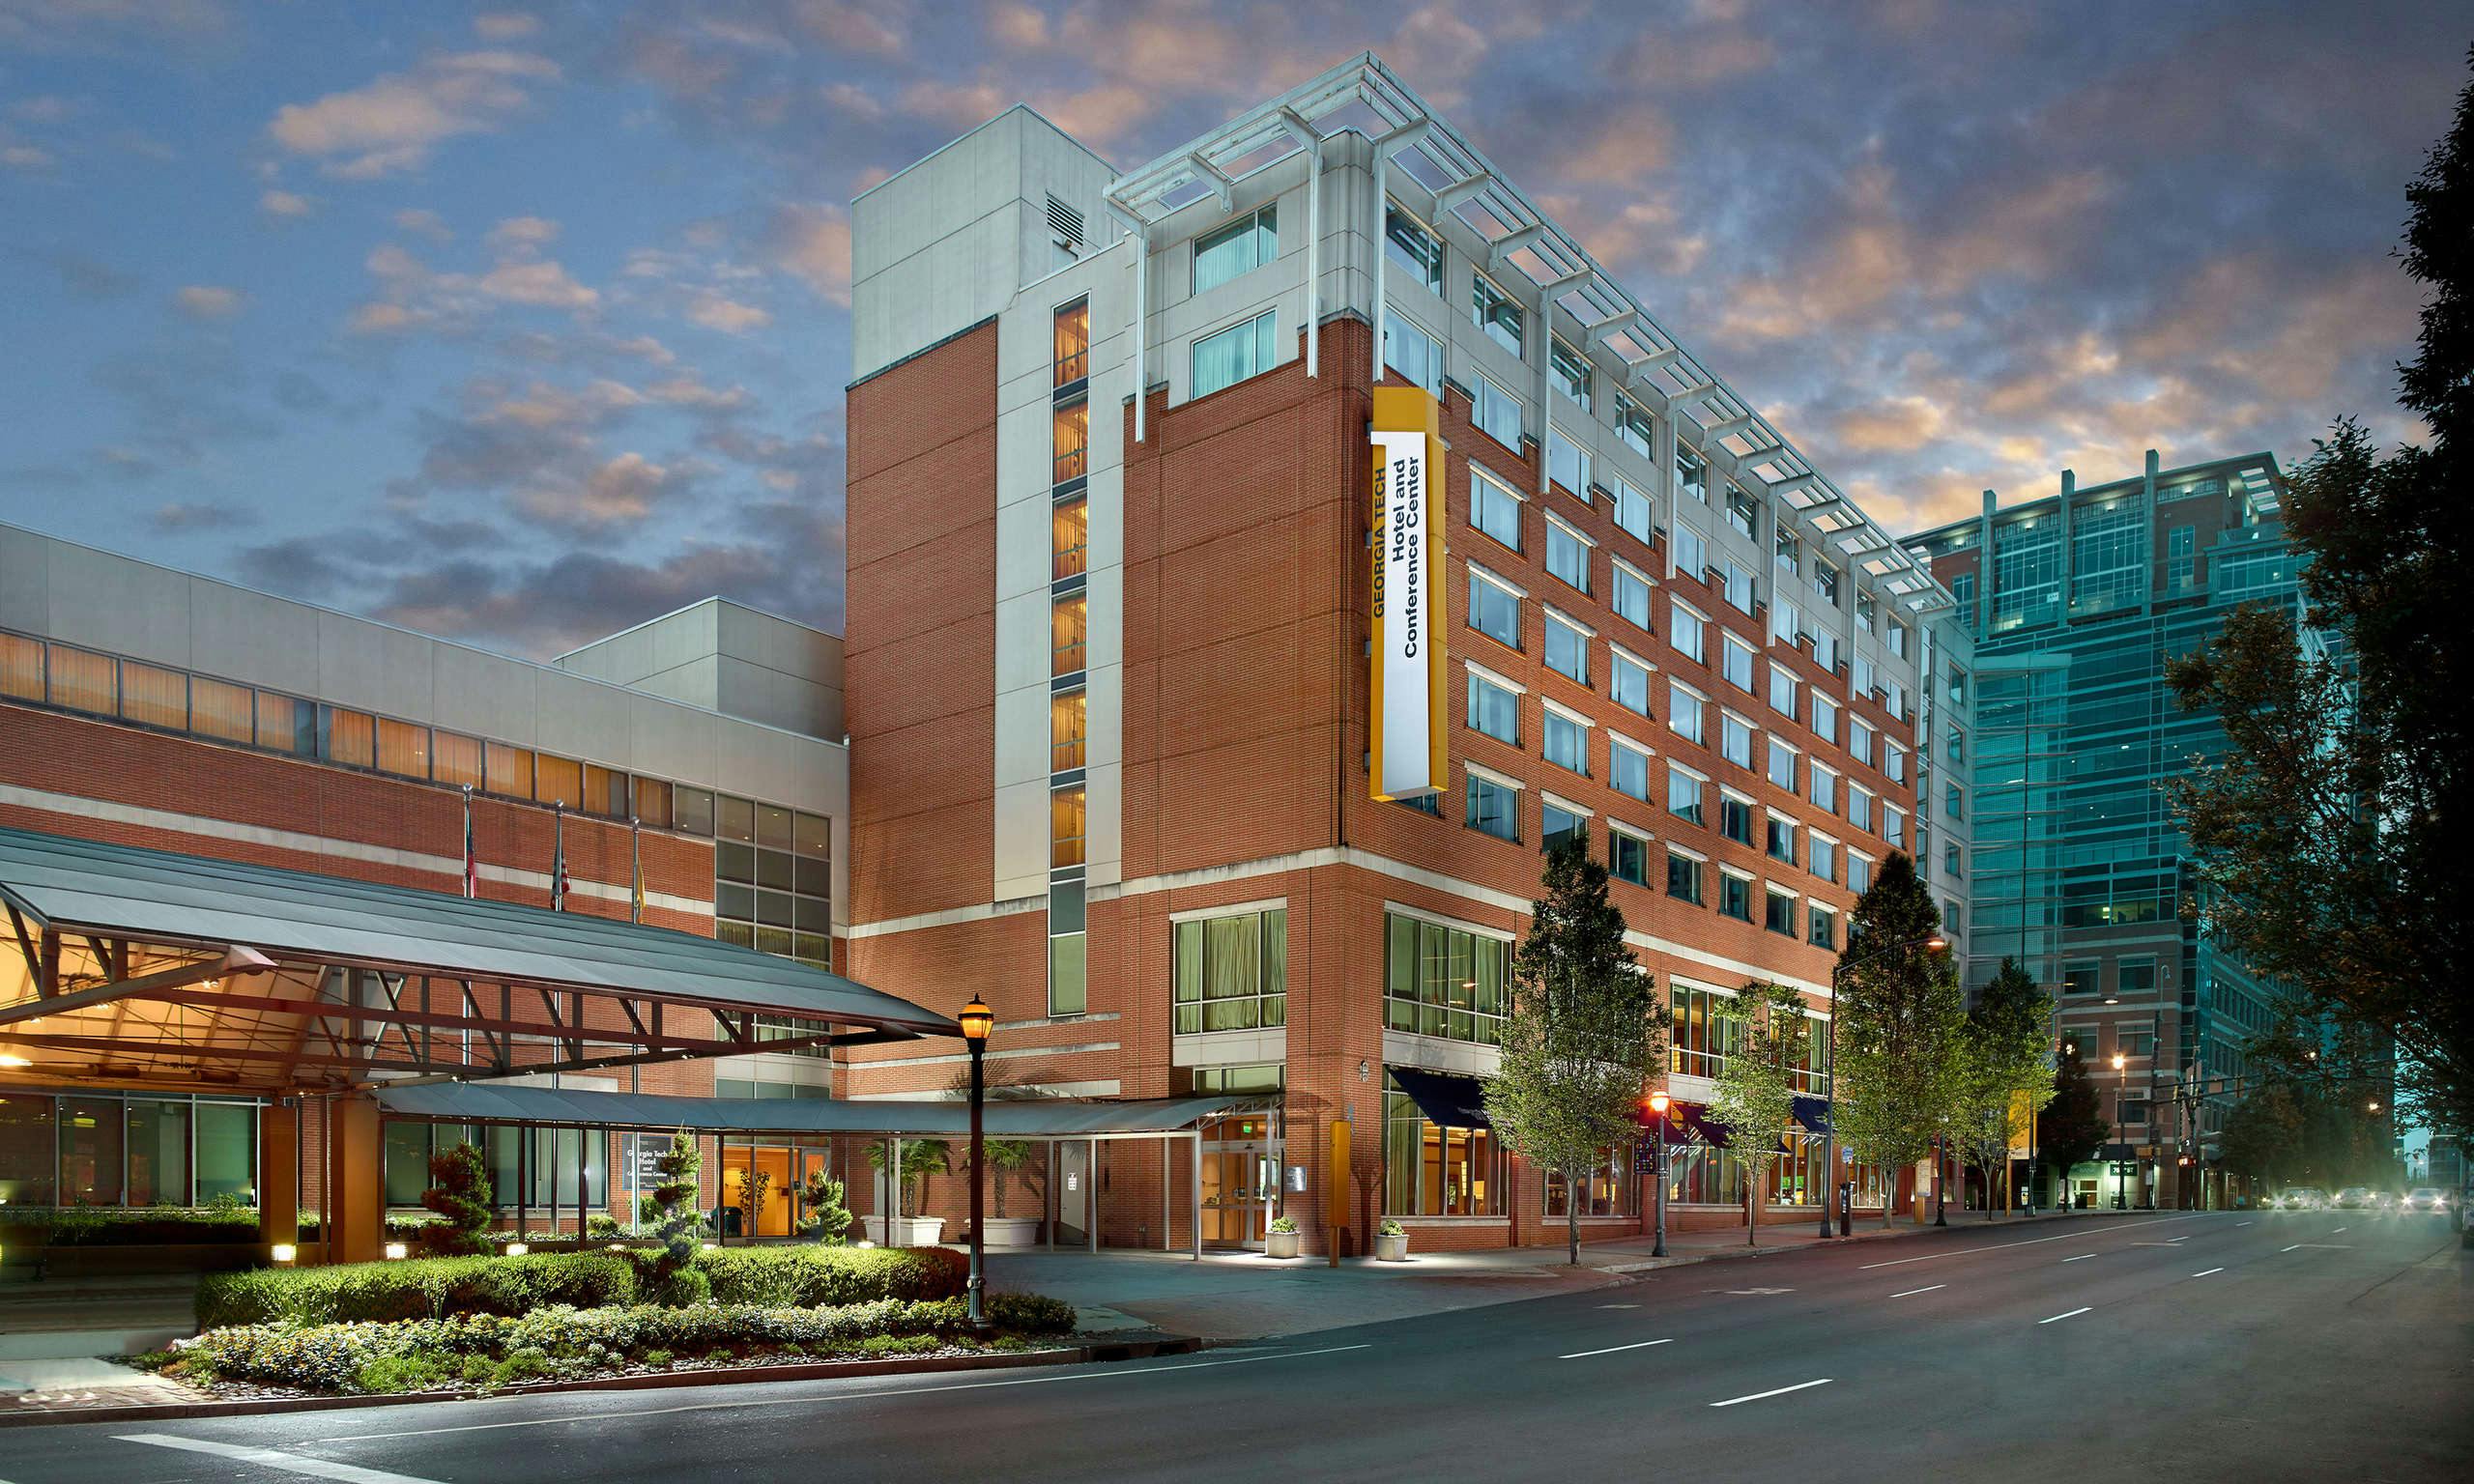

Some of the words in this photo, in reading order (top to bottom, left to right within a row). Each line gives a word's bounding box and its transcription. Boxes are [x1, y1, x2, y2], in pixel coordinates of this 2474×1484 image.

[1374, 468, 1386, 523] TECH
[1394, 459, 1405, 499] and
[1406, 457, 1419, 528] Center
[1393, 505, 1405, 562] Hotel
[1374, 526, 1385, 618] GEORGIA
[1404, 533, 1419, 659] Conference
[627, 1149, 652, 1157] Grgia
